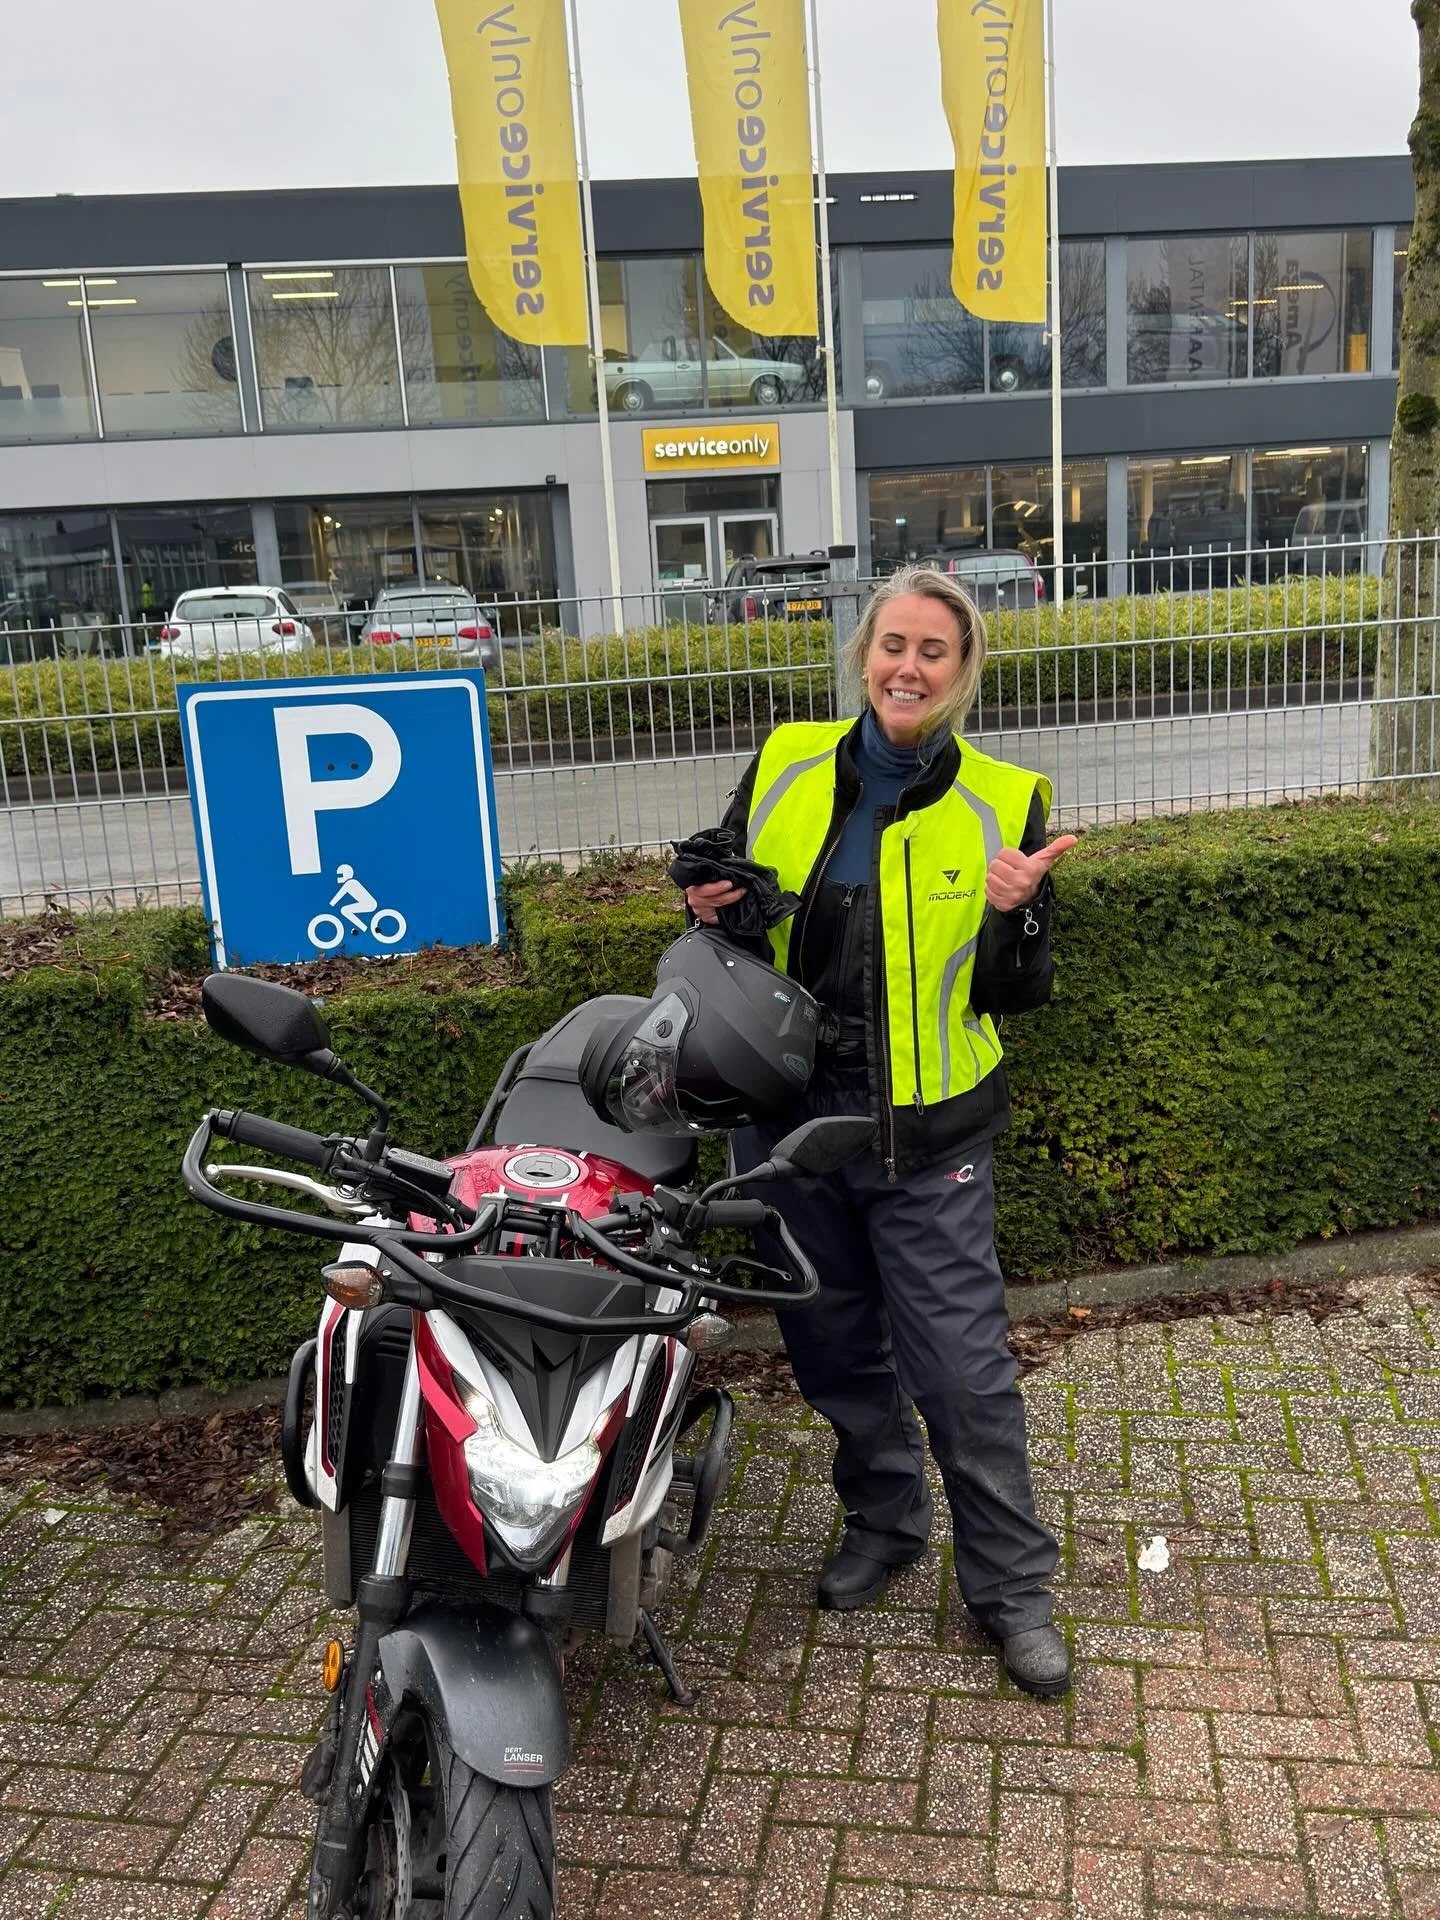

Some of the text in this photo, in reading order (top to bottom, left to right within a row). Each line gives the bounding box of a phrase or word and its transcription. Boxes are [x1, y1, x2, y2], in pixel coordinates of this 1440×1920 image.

[655, 433, 769, 458] serviceonly
[273, 704, 401, 875] P
[928, 889, 976, 902] MODEKA
[504, 1753, 543, 1763] LANSER
